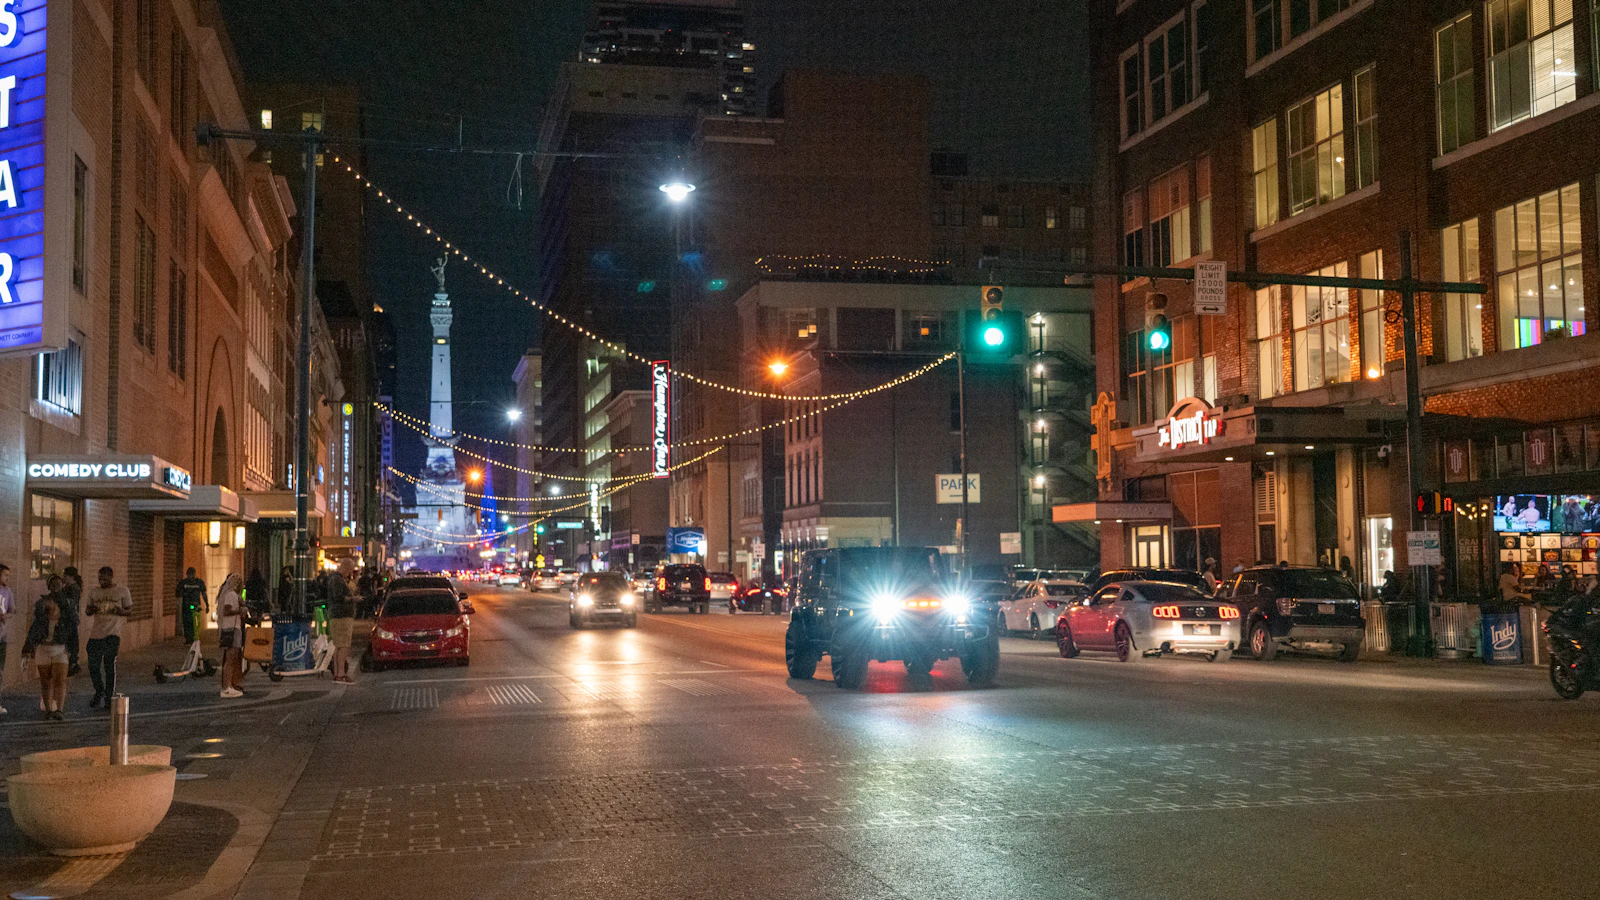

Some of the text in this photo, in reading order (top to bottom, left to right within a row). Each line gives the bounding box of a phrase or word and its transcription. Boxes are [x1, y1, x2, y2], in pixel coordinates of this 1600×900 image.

[12, 331, 34, 340] COMPANY
[654, 366, 668, 472] Hampton Inn
[1203, 419, 1217, 438] TAP
[28, 463, 151, 478] COMEDY CLUB
[282, 631, 308, 661] Indy
[1490, 621, 1517, 650] Indy
